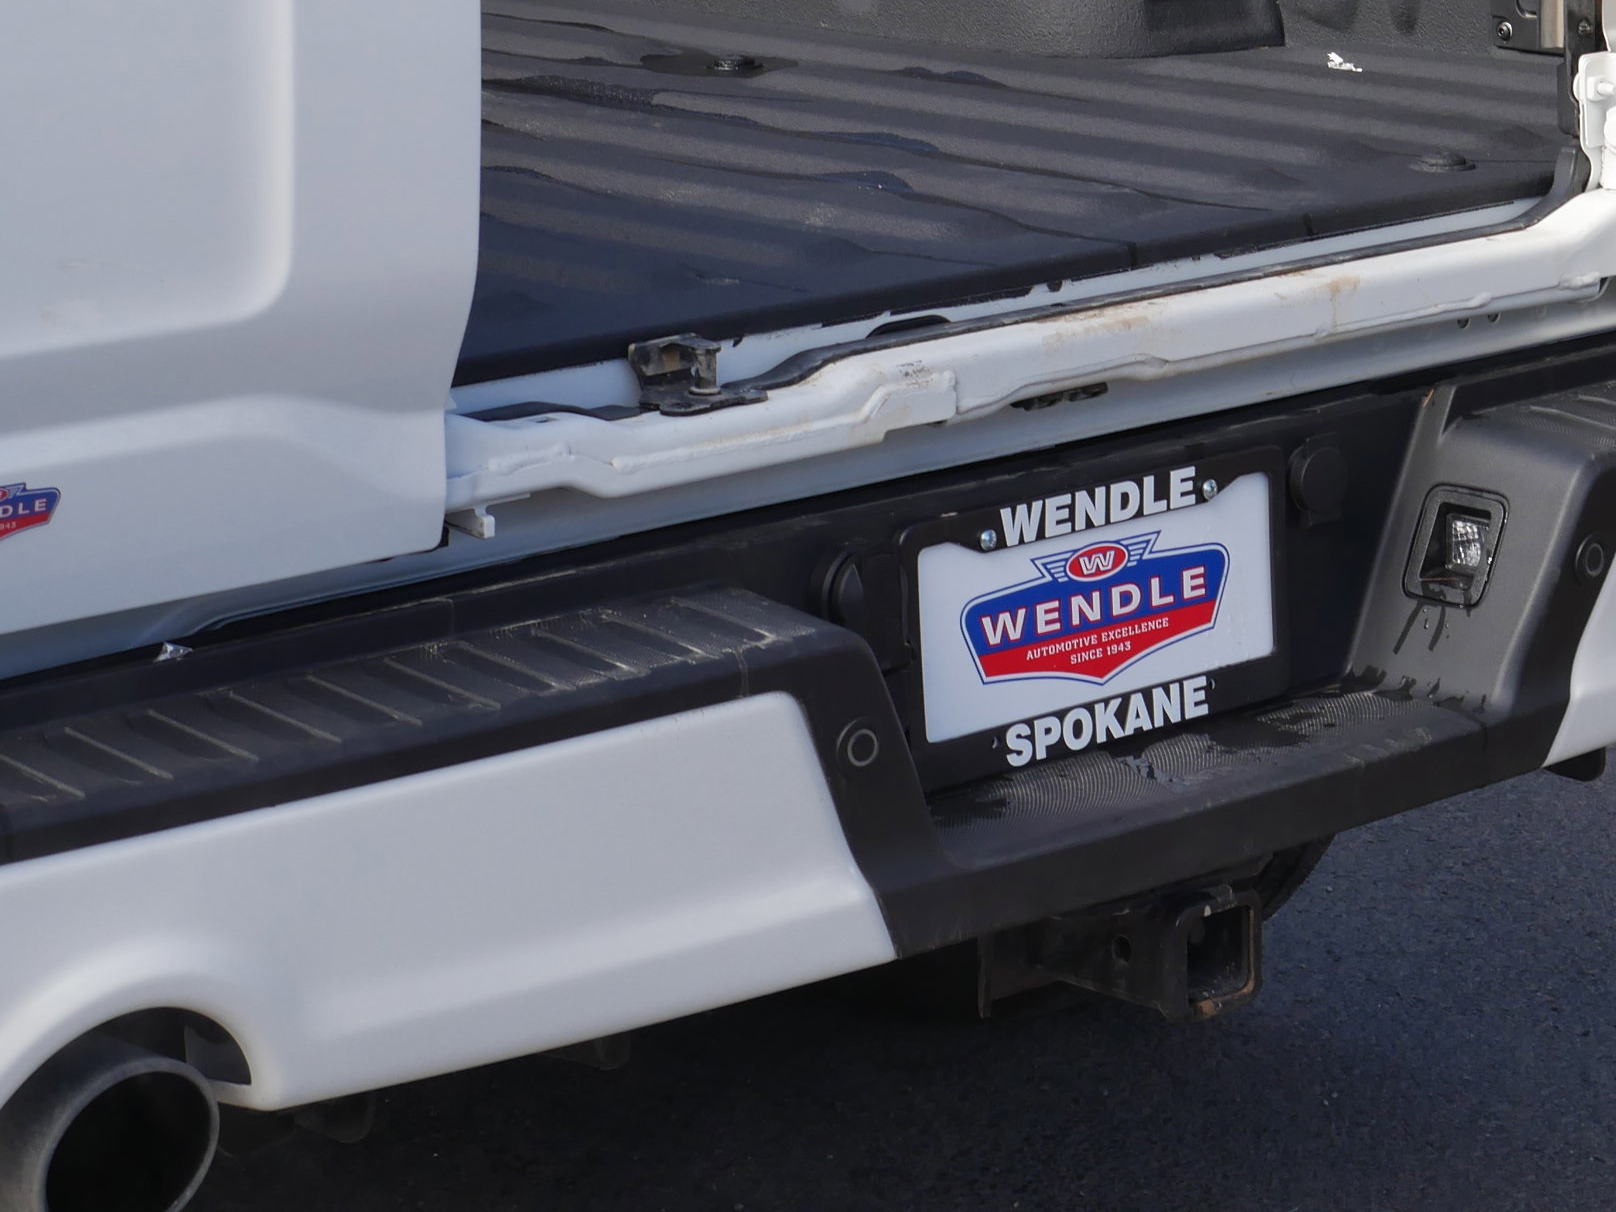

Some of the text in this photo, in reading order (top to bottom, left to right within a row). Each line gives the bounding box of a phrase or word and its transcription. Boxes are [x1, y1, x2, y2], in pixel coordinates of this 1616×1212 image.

[1000, 466, 1196, 546] WENDLE
[1078, 549, 1115, 575] W
[981, 565, 1206, 646] WENDLE
[1026, 617, 1169, 660] AUTOMOTIVE EXCELLENCE
[1070, 641, 1131, 665] SINCE 1943
[1005, 675, 1209, 767] SPOKANE
